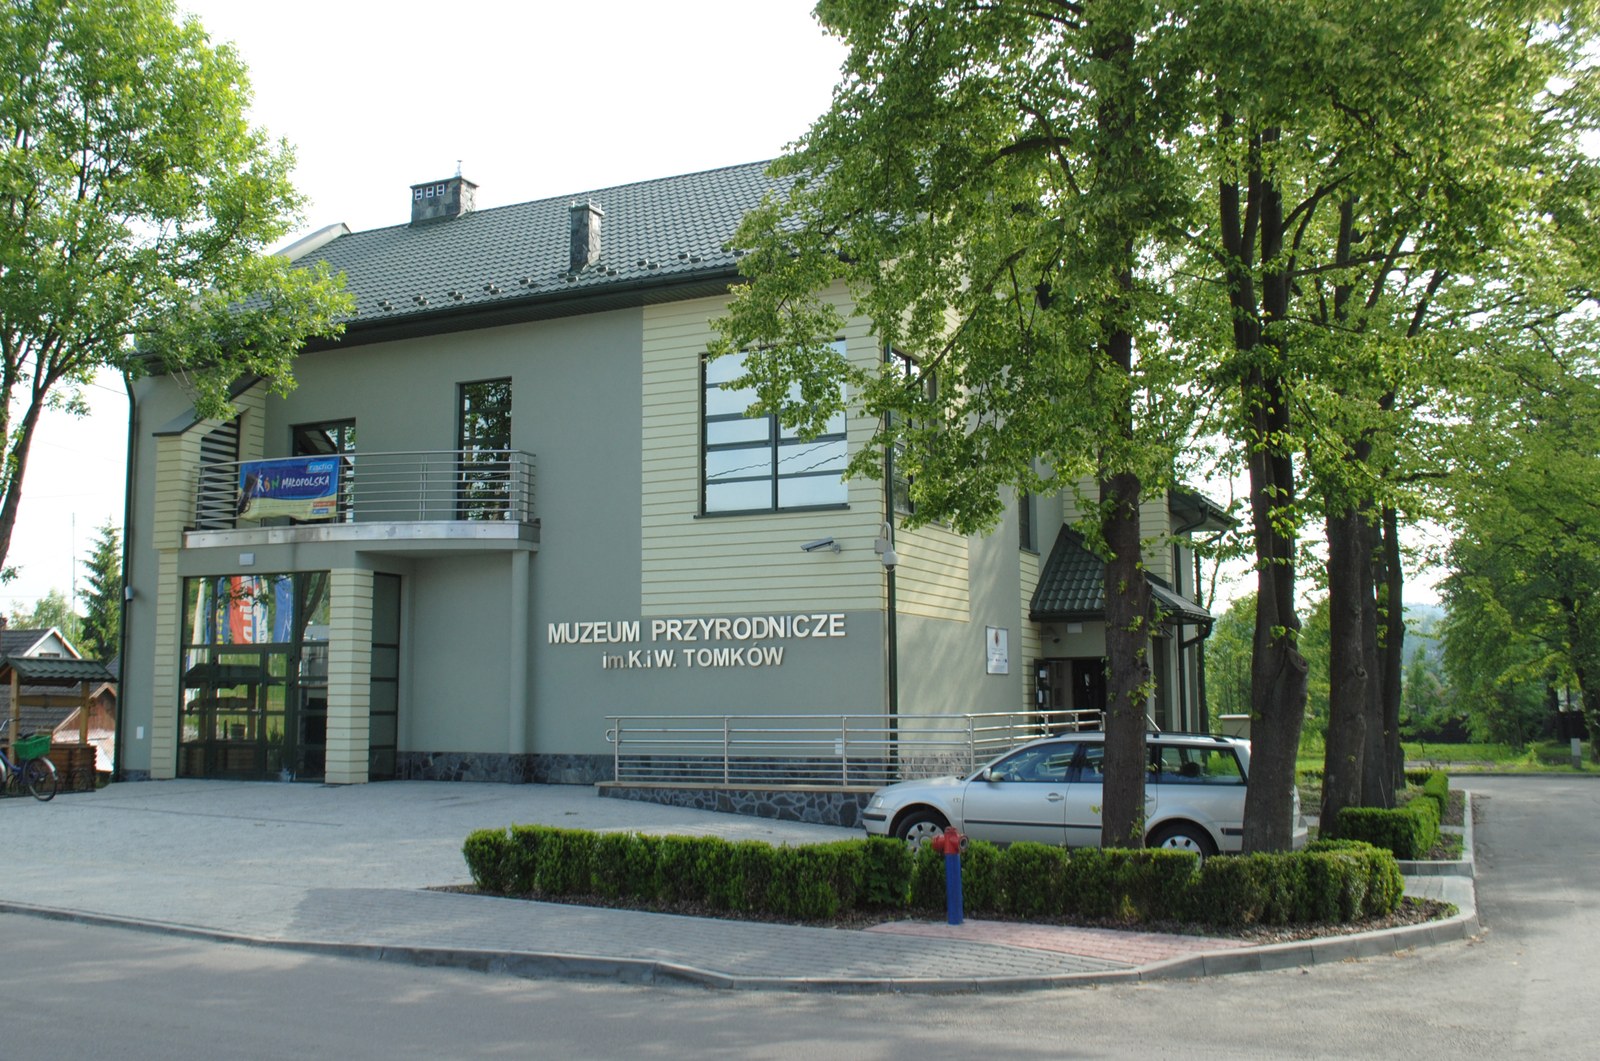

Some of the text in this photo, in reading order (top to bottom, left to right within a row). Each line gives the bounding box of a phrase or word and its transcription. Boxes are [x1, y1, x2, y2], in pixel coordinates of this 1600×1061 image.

[309, 463, 333, 472] radio
[547, 613, 847, 644] MUZEUM PRZYRODNICZE
[682, 641, 784, 668] TOMKÓW
